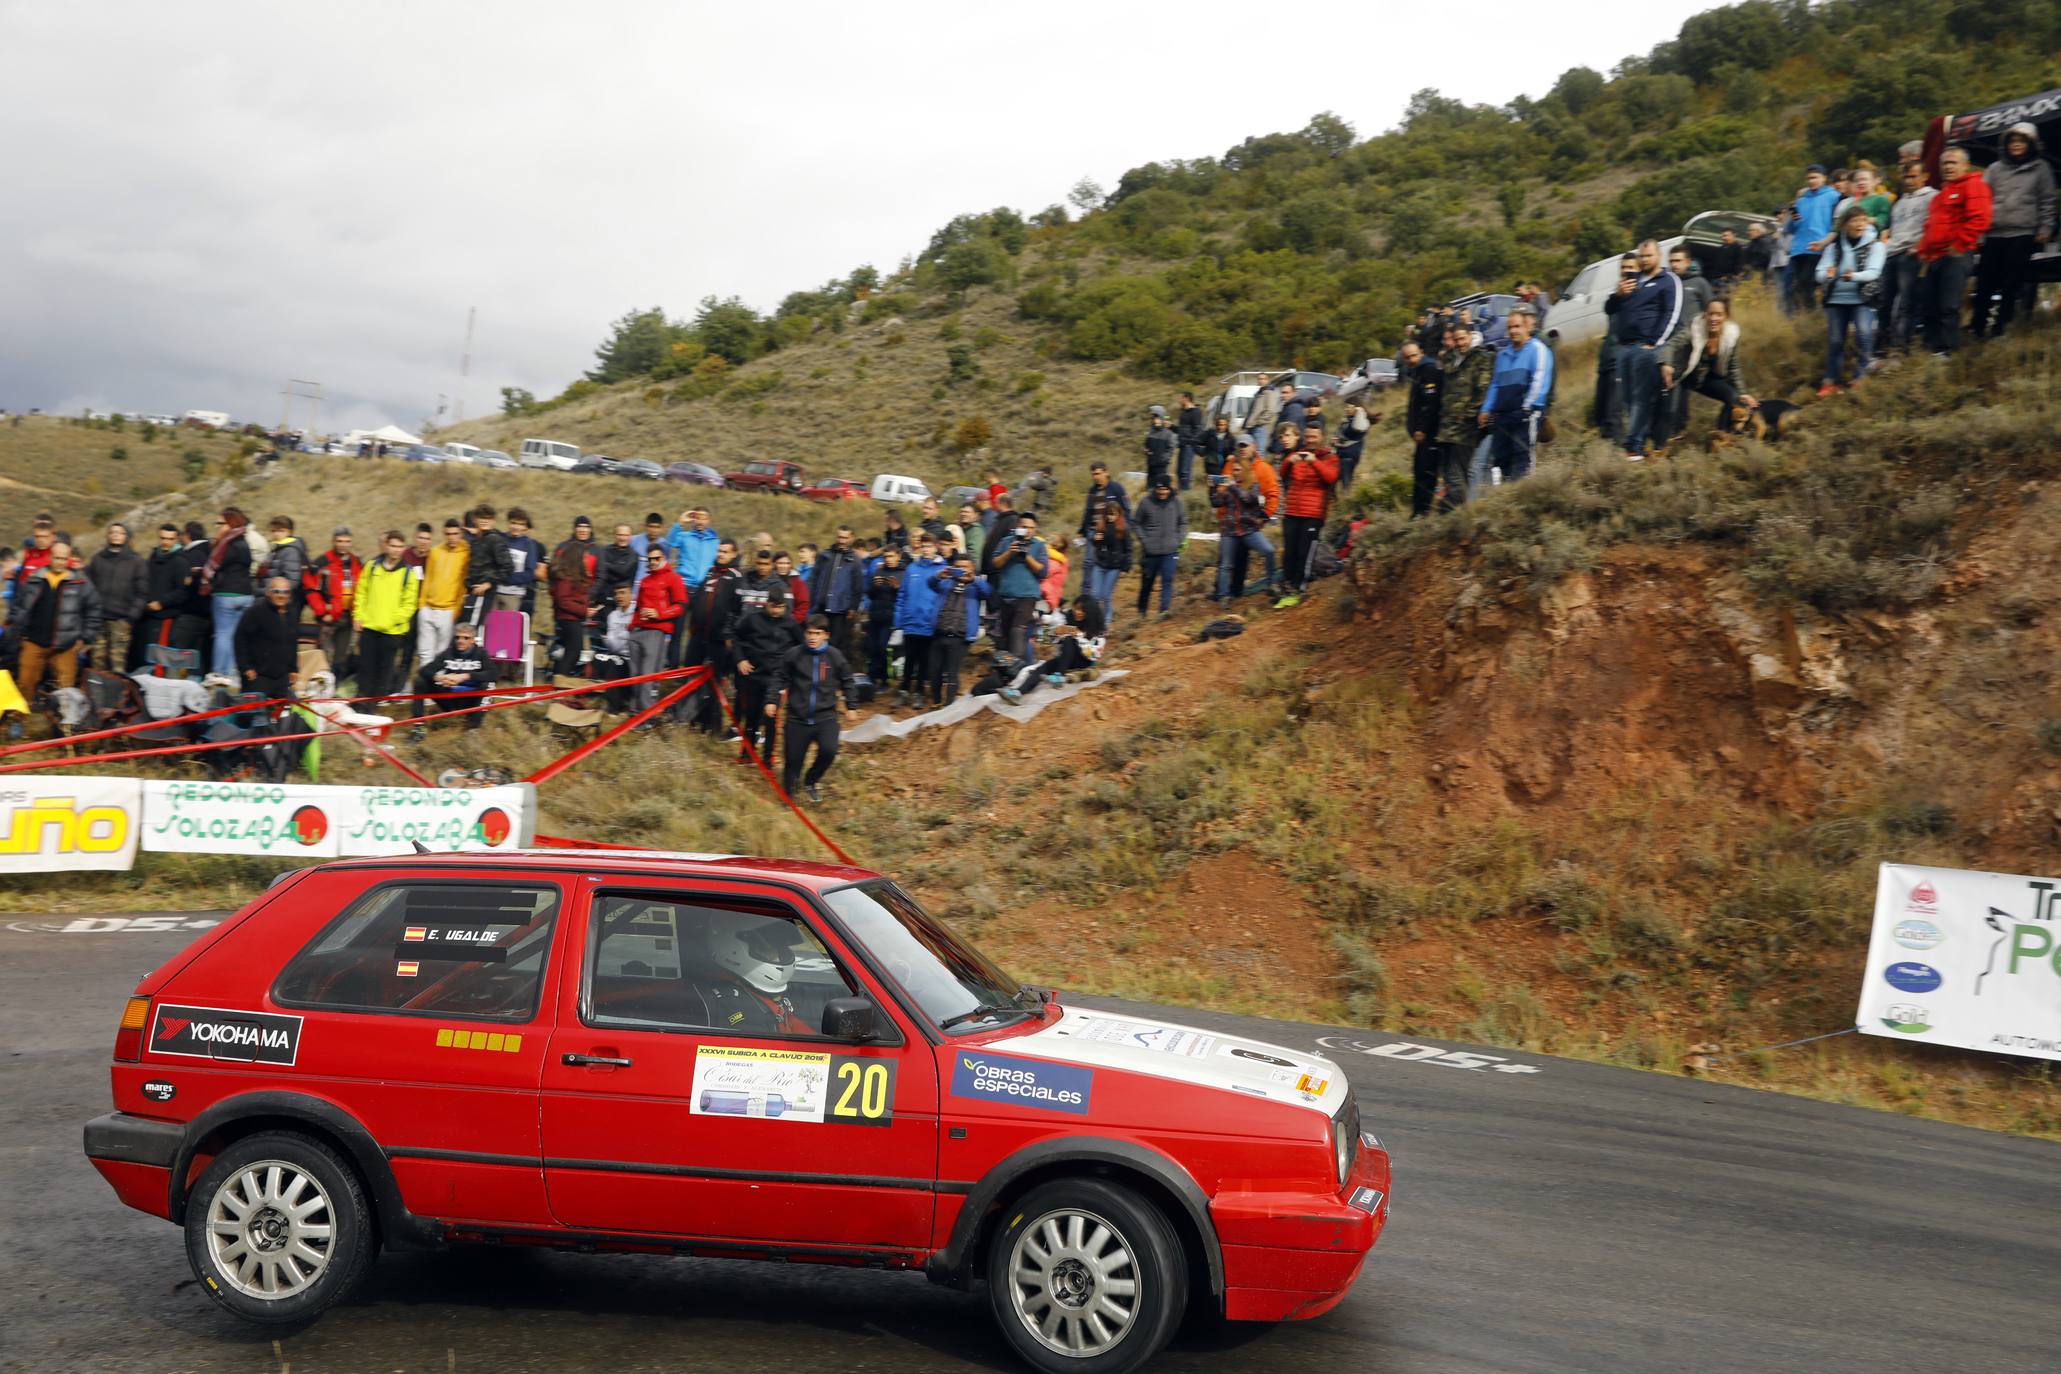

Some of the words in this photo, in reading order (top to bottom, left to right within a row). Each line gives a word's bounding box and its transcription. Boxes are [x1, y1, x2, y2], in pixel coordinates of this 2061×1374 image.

[167, 784, 286, 810] REDONDO
[360, 788, 472, 815] REDONDO
[428, 929, 440, 941] E.
[445, 929, 500, 942] UGALDE
[190, 1021, 290, 1049] YOKOHAMA
[727, 1049, 758, 1057] SUBIDA
[145, 1083, 175, 1092] mares
[833, 1061, 889, 1119] 20
